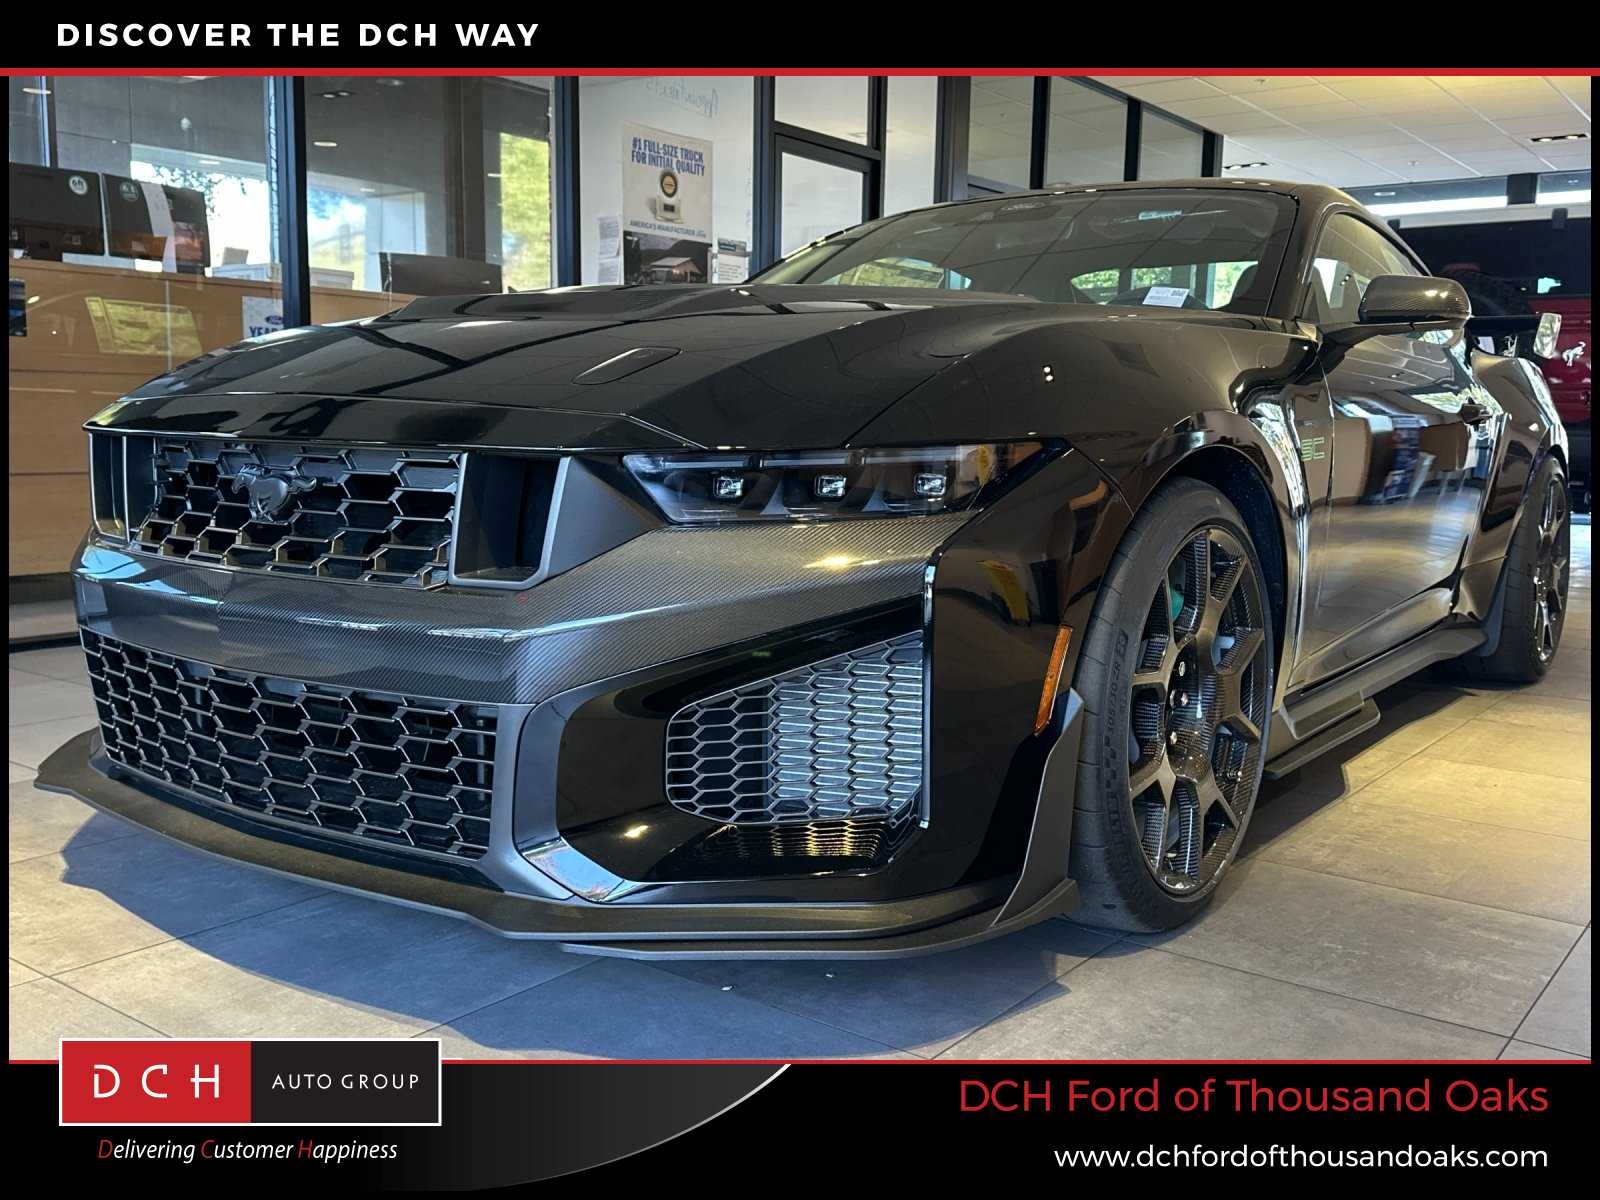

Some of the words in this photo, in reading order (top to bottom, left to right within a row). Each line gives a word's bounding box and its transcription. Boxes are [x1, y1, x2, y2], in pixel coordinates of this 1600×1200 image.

[632, 136, 642, 151] #1
[643, 138, 679, 160] FULL-SIZE
[680, 147, 704, 163] TRUCK
[631, 150, 647, 164] FOR
[648, 153, 674, 171] INITIAL
[675, 159, 705, 177] QUALITY
